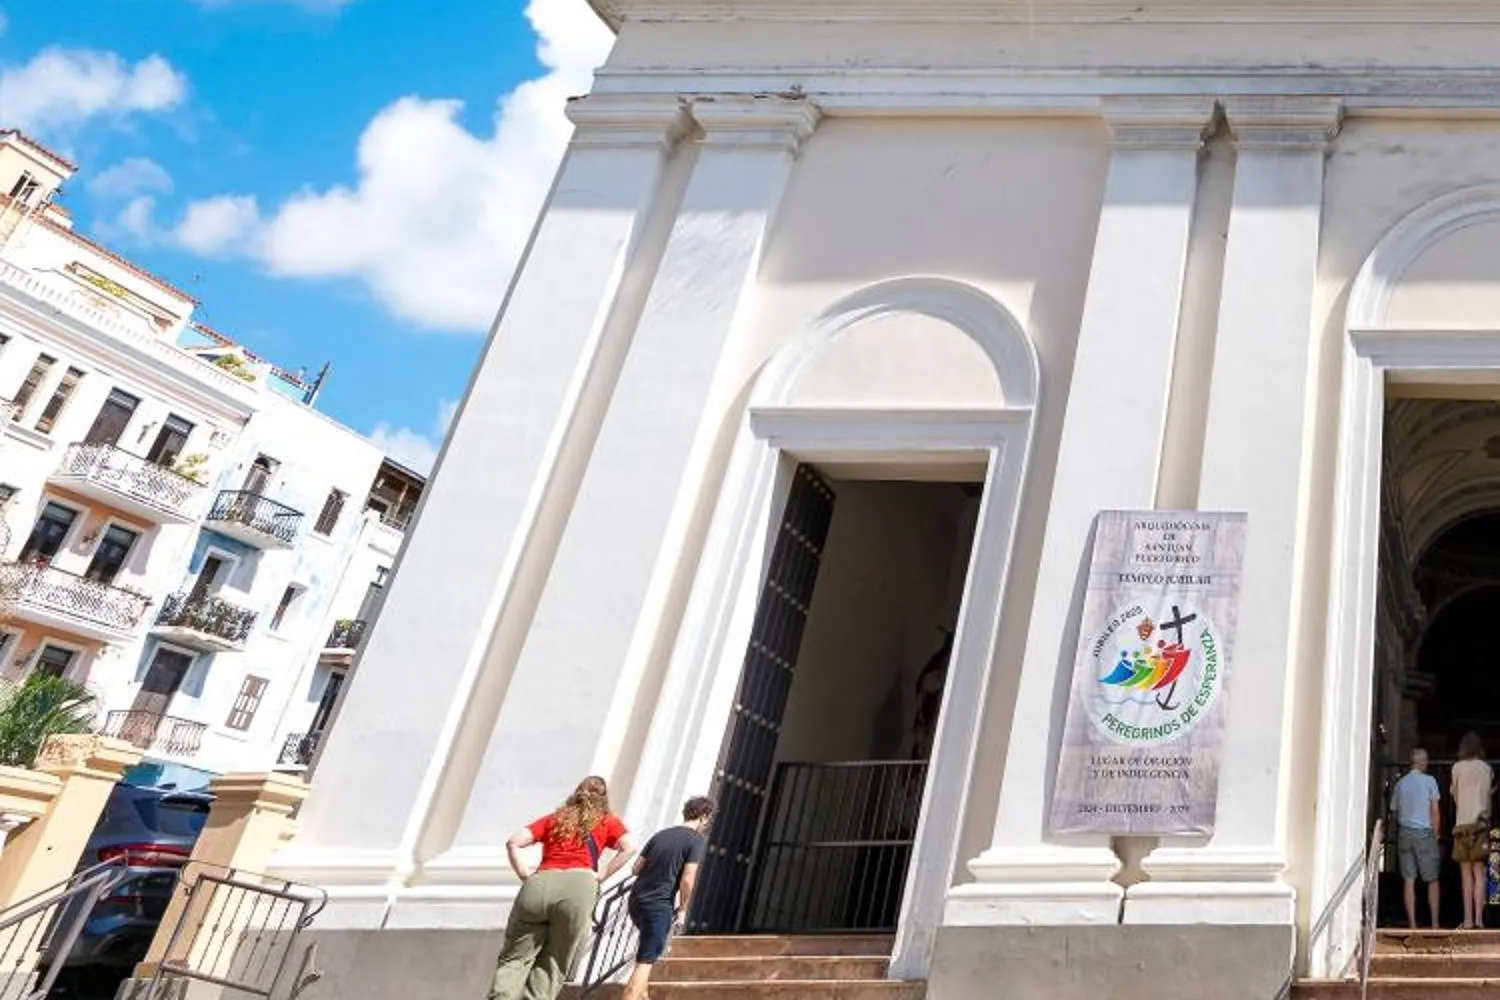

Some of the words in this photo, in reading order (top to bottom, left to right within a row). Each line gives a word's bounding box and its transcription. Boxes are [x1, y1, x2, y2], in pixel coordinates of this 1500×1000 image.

[1101, 712, 1182, 741] PEREGRINOS
[1179, 703, 1200, 725] DE
[1193, 626, 1218, 703] ESPERANZA
